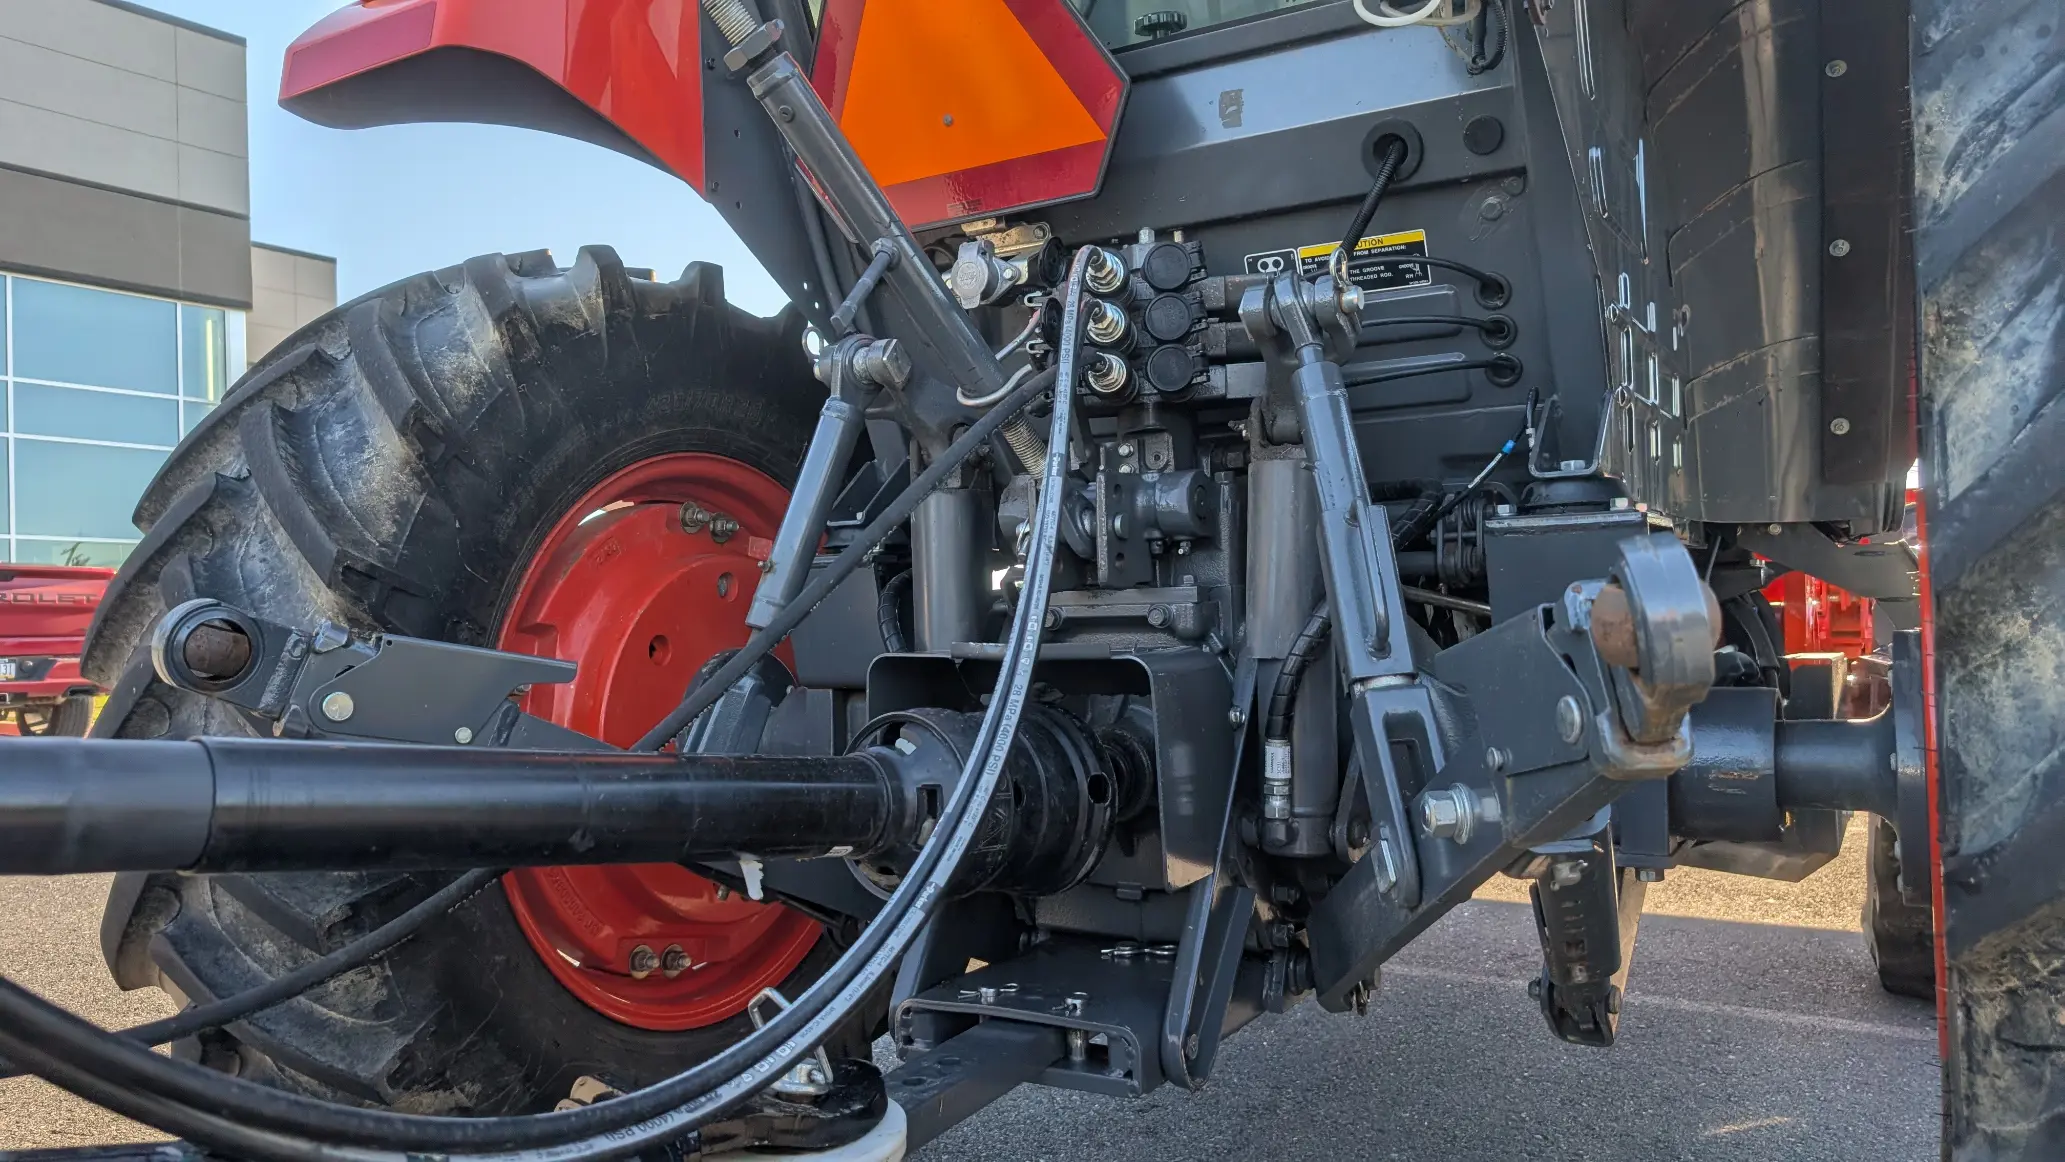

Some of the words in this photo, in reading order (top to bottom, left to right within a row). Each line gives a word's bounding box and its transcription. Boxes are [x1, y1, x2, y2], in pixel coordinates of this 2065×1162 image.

[1353, 249, 1370, 257] FROM
[1356, 238, 1384, 250] UTION
[1362, 265, 1385, 273] GROOVE
[1052, 455, 1060, 476] Parker
[1013, 684, 1023, 696] 28
[1005, 699, 1019, 721] MPa
[994, 724, 1012, 752] (4000
[985, 754, 1001, 776] PSI)
[914, 884, 935, 909] Parker
[636, 1113, 675, 1133] (4000
[604, 1129, 636, 1141] PSI)
